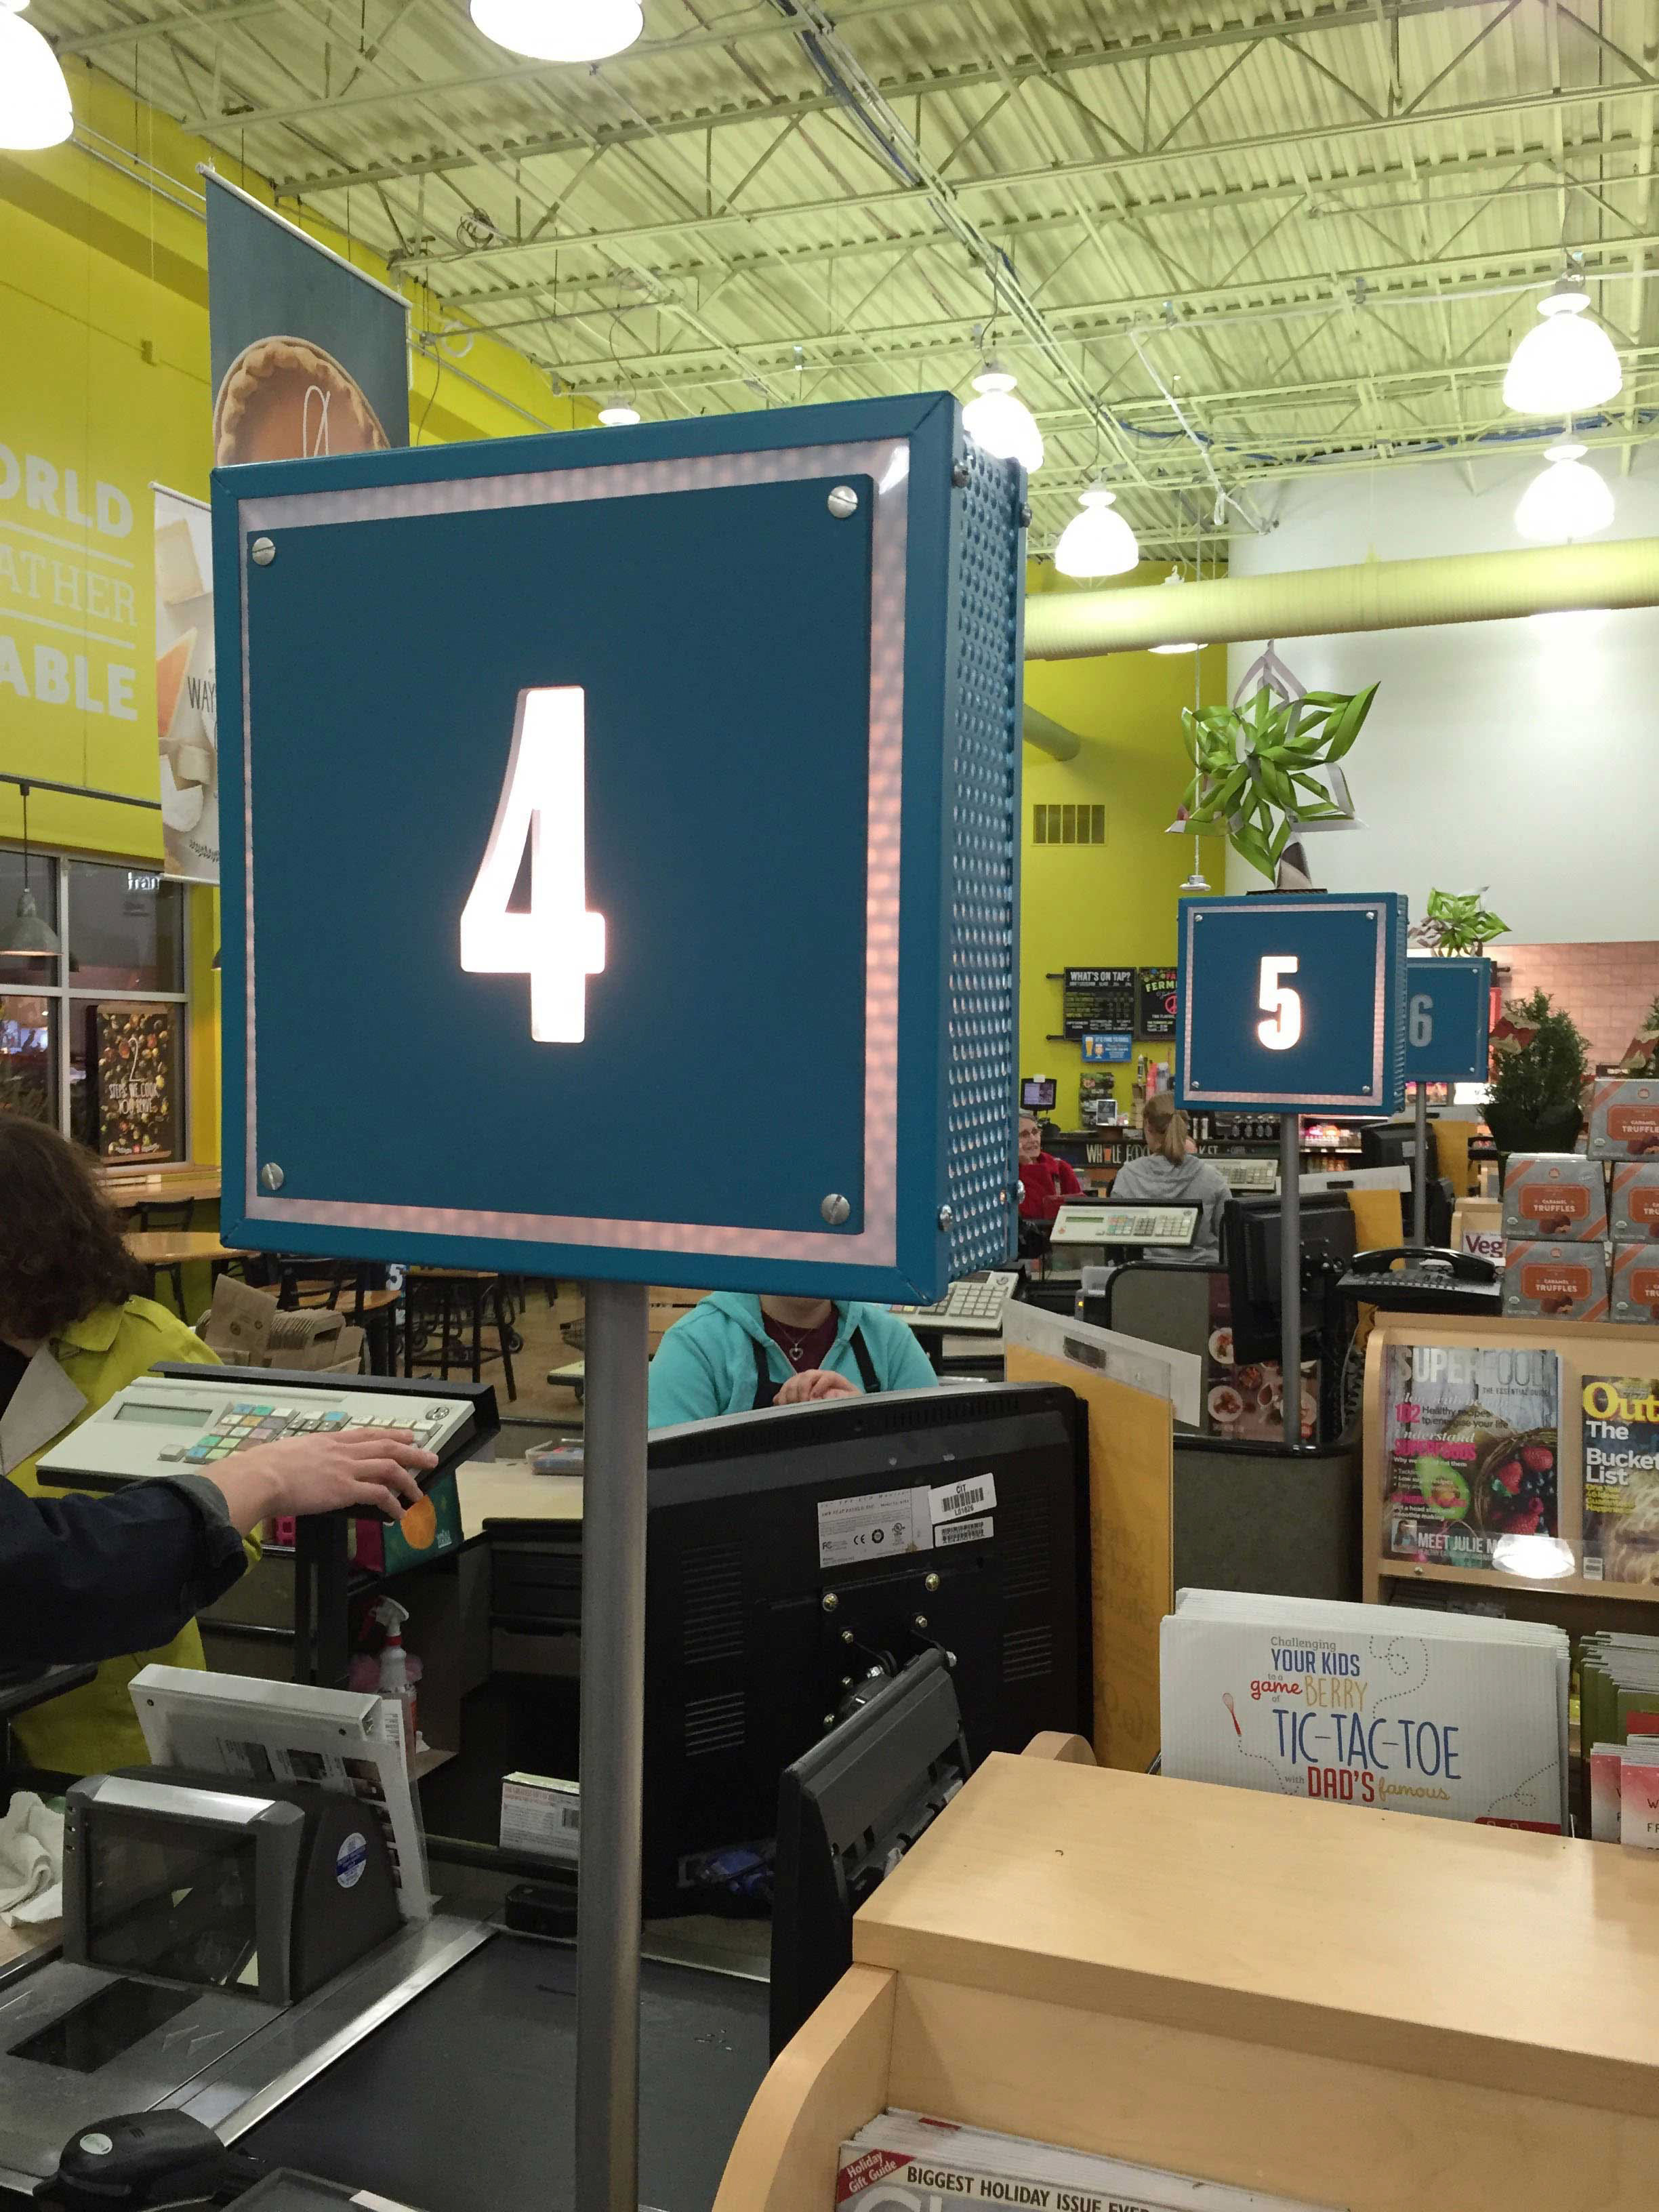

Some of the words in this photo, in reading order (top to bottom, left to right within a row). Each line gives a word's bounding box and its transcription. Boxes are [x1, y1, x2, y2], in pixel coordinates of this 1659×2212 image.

[460, 686, 606, 1043] 4
[1070, 971, 1099, 981] WHAT'S
[1101, 971, 1111, 981] ON
[1113, 971, 1131, 981] TAP?
[1257, 956, 1302, 1050] 5
[1409, 995, 1433, 1047] 6
[1465, 1235, 1506, 1258] Veg
[1422, 1406, 1457, 1416] Healthy
[1586, 1420, 1629, 1440] The
[1586, 1465, 1629, 1486] List
[1418, 1532, 1449, 1550] MEET
[1452, 1536, 1483, 1552] JULIE
[1271, 1636, 1336, 1651] Challenging
[1271, 1648, 1316, 1673] YOUR
[1322, 1652, 1361, 1677] KIDS
[1267, 1672, 1277, 1681] to
[1250, 1680, 1303, 1700] game
[1305, 1675, 1368, 1712] BERRY
[1272, 1694, 1280, 1702] of
[1273, 1708, 1462, 1780] TIC-TAC-TOE
[1284, 1775, 1305, 1785] with
[1307, 1766, 1375, 1803] DAD'S
[1378, 1776, 1451, 1802] famous
[847, 2152, 883, 2179] Holiday
[849, 2175, 869, 2194] Gift
[869, 2160, 898, 2180] Guide
[907, 2166, 975, 2193] BIGGEST
[981, 2179, 1050, 2207] HOLIDAY
[1057, 2192, 1102, 2212] ISSUE
